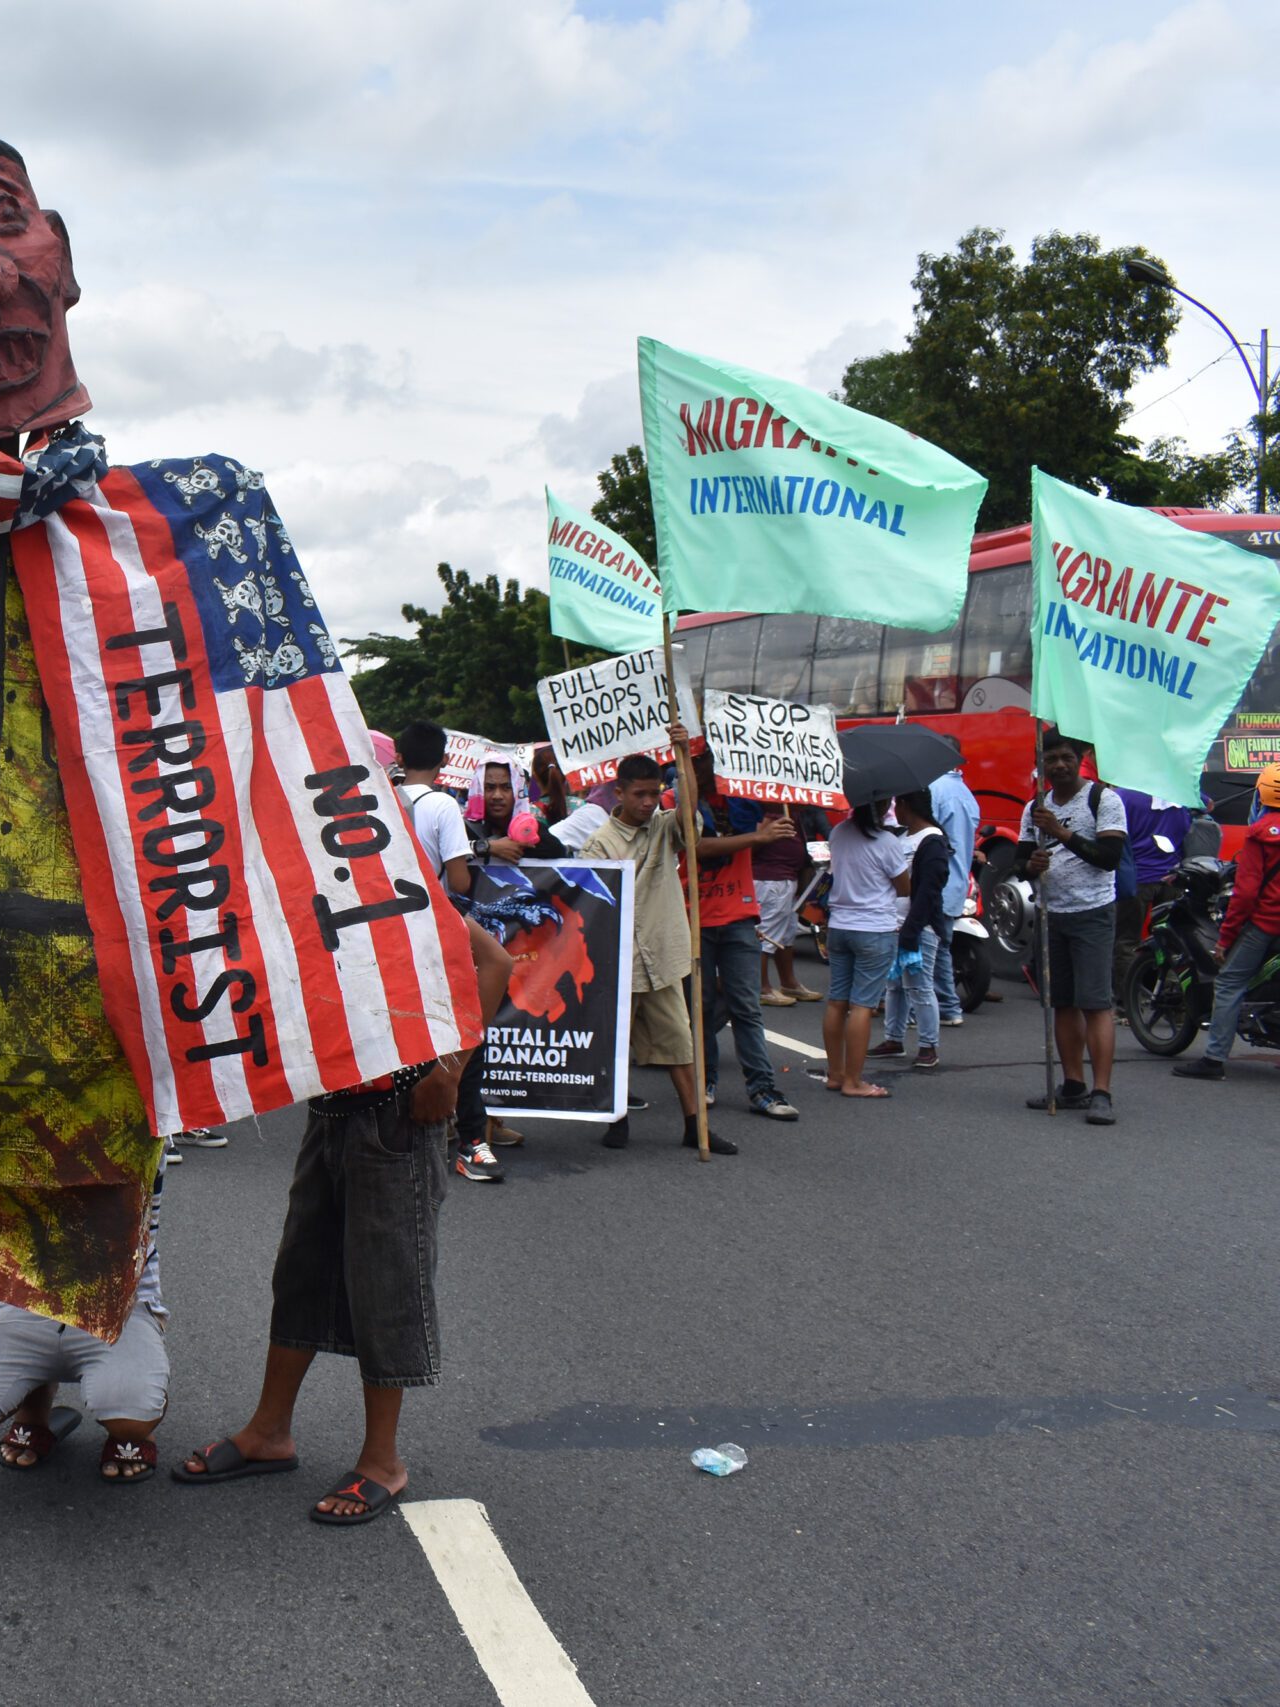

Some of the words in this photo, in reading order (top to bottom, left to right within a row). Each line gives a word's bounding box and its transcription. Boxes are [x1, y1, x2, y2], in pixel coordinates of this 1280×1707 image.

[690, 475, 906, 536] INTERNATIONAL
[548, 668, 605, 704] PULL
[616, 649, 654, 681] OUT
[553, 682, 641, 727] TROOPS
[723, 694, 811, 727] STOP
[450, 735, 475, 751] TOP
[562, 697, 682, 758] MINDANAO!
[708, 721, 749, 747] AIR
[751, 726, 836, 760] STRIKES
[728, 779, 834, 806] MIGRANTE
[105, 601, 269, 1068] TERRORIST
[487, 1026, 546, 1046] RTIAL
[549, 1029, 593, 1049] LAW
[484, 1046, 567, 1067] DANAO!
[489, 1069, 595, 1085] STATE-TERRORISM!
[490, 1088, 510, 1096] MAYO
